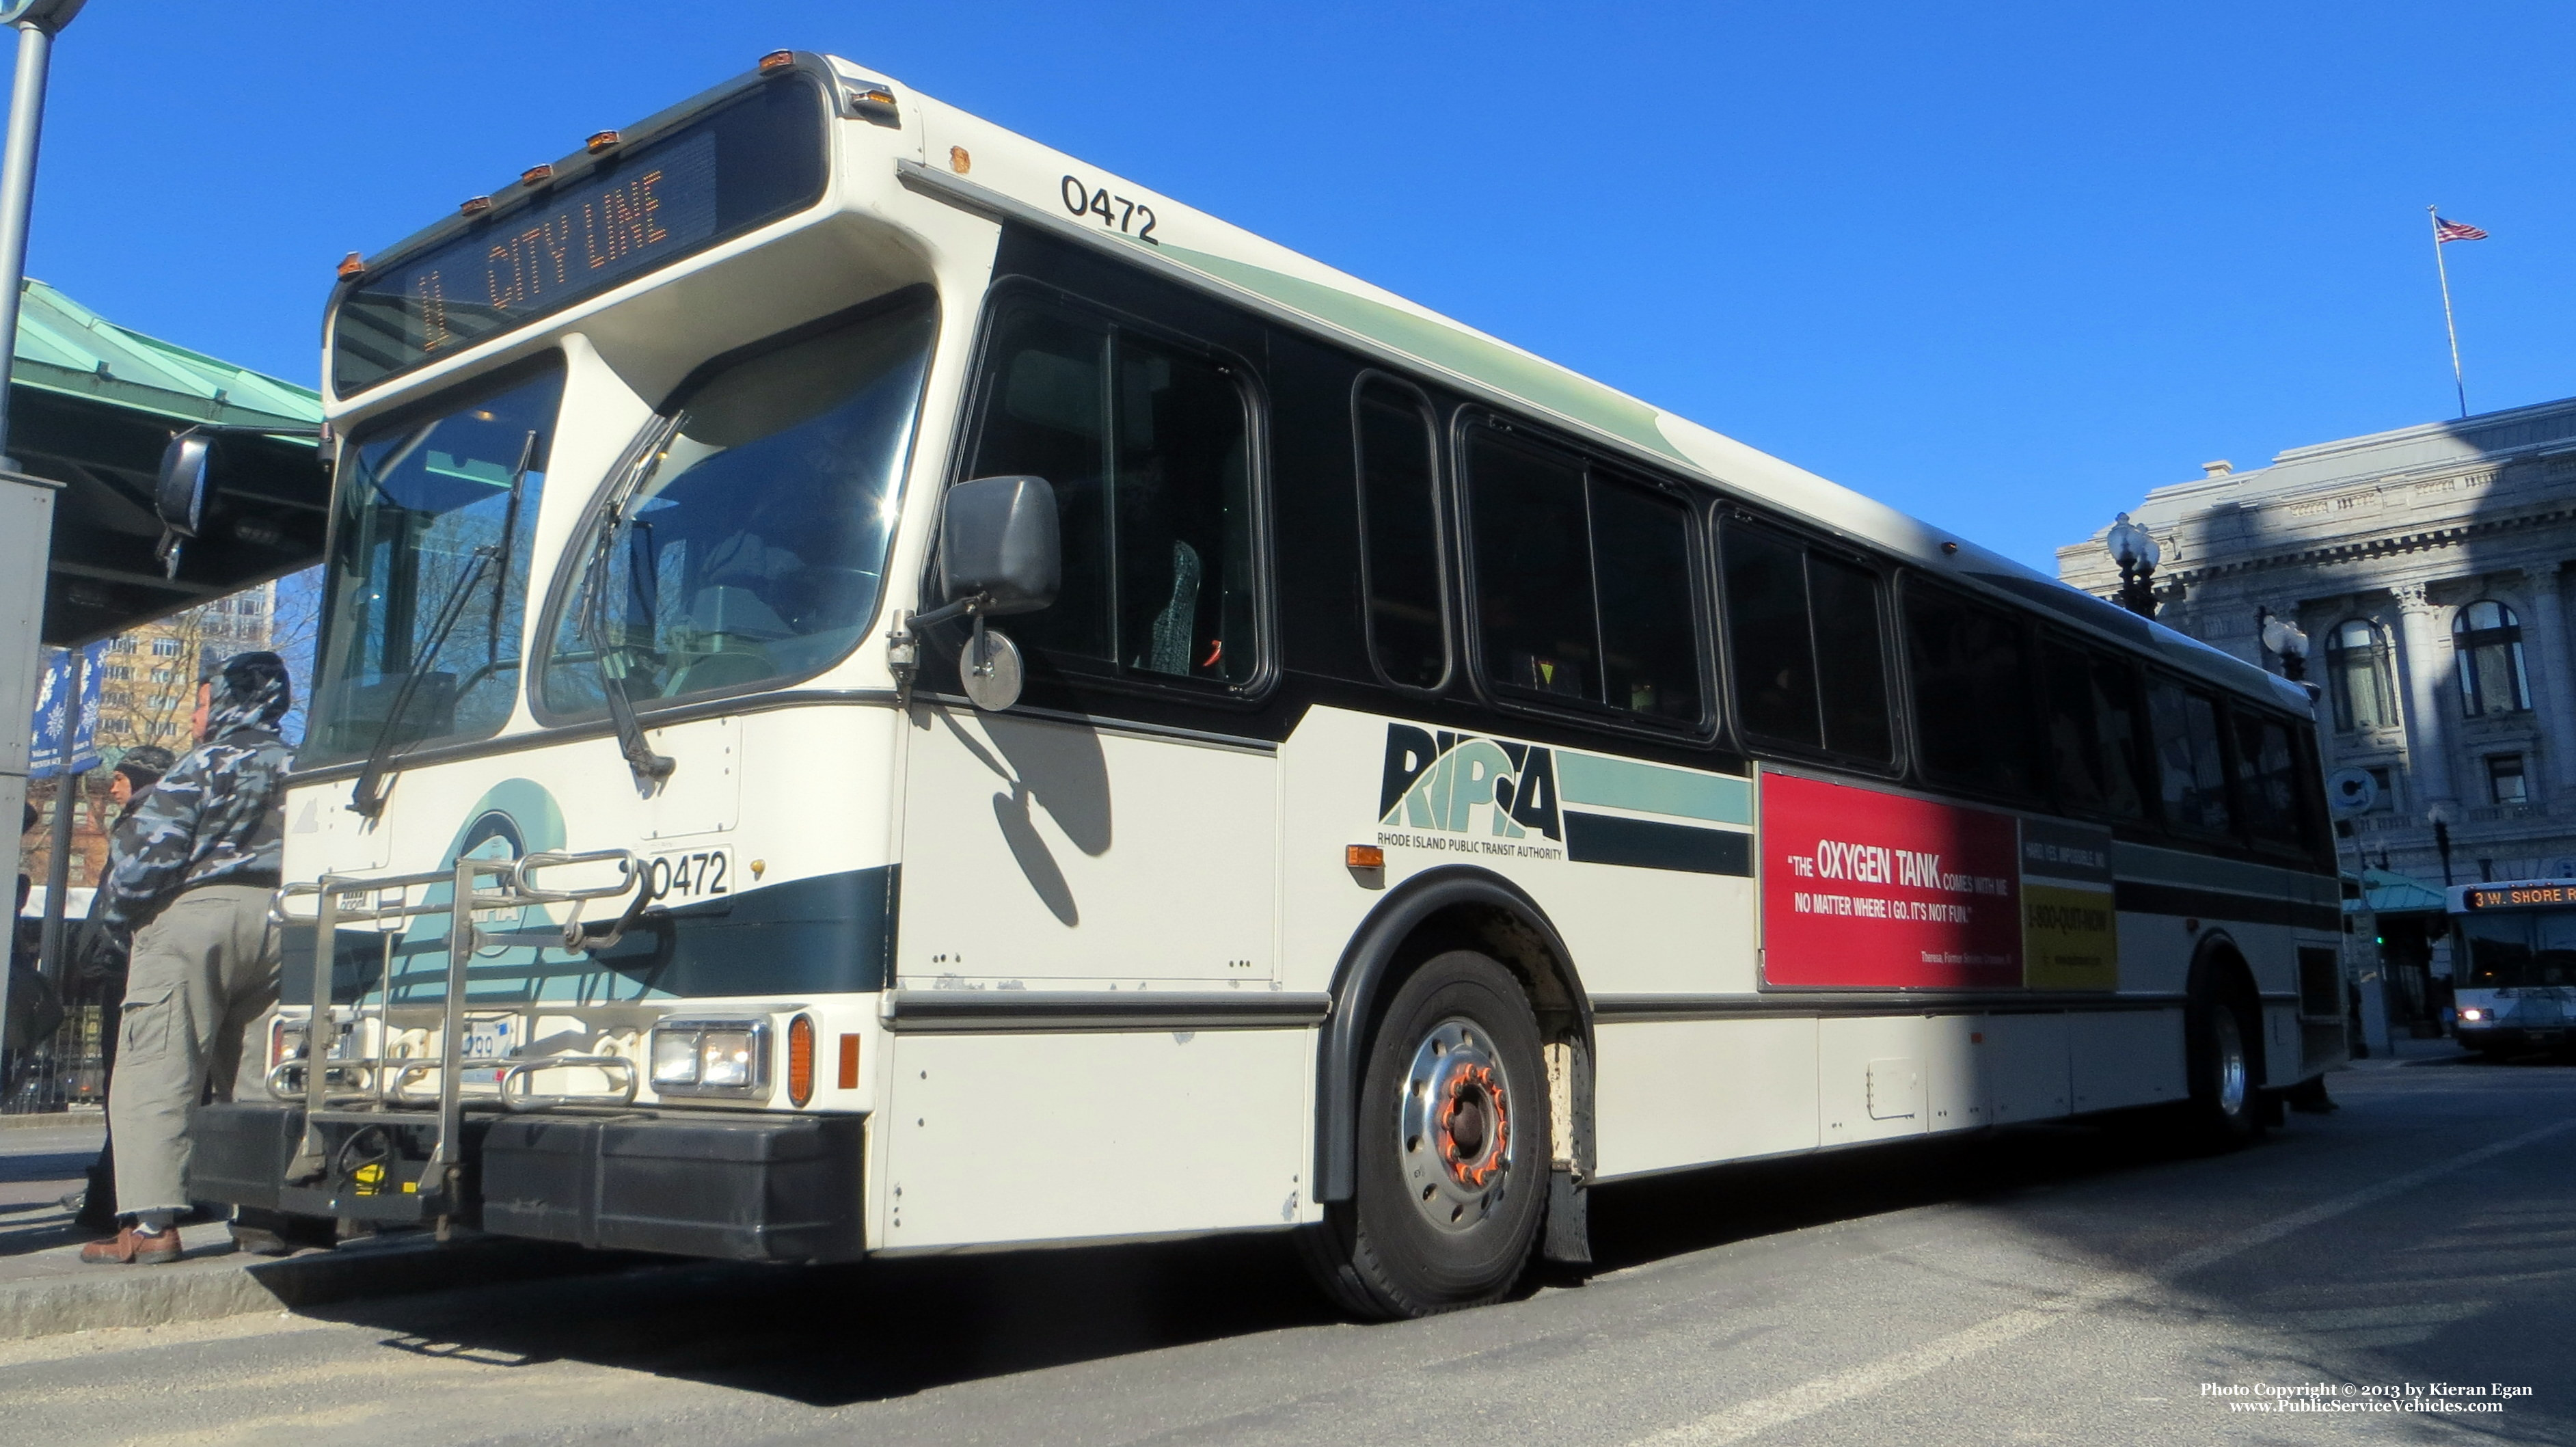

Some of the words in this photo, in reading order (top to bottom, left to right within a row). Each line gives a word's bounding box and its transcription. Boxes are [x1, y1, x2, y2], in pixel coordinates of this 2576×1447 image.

[1061, 175, 1159, 246] 0472
[489, 214, 569, 310] CITY
[584, 170, 668, 269] LINE
[1378, 832, 1410, 847] RHODE
[1413, 836, 1446, 850] ISLAND
[1449, 839, 1479, 853] PUBLIC
[1482, 842, 1515, 856] TRANSIT
[1517, 846, 1562, 860] AUTHORITY
[1817, 839, 1890, 884] OXYGEN
[1895, 849, 1941, 889] TANK
[1943, 873, 1973, 893] COMES
[1974, 876, 1994, 895] WITH
[1995, 878, 2008, 897] ME
[651, 851, 727, 900] 0472
[2475, 893, 2484, 907] 3
[2488, 893, 2507, 905] W.
[2512, 889, 2562, 903] SHORE
[1795, 892, 1810, 912] NO
[1813, 893, 1852, 916] MATTER
[1853, 897, 1887, 919] WHERE
[1888, 900, 1892, 919] I
[1893, 901, 1910, 920] GO.
[1911, 902, 1927, 921] IT'S
[1929, 904, 1947, 922] NOT
